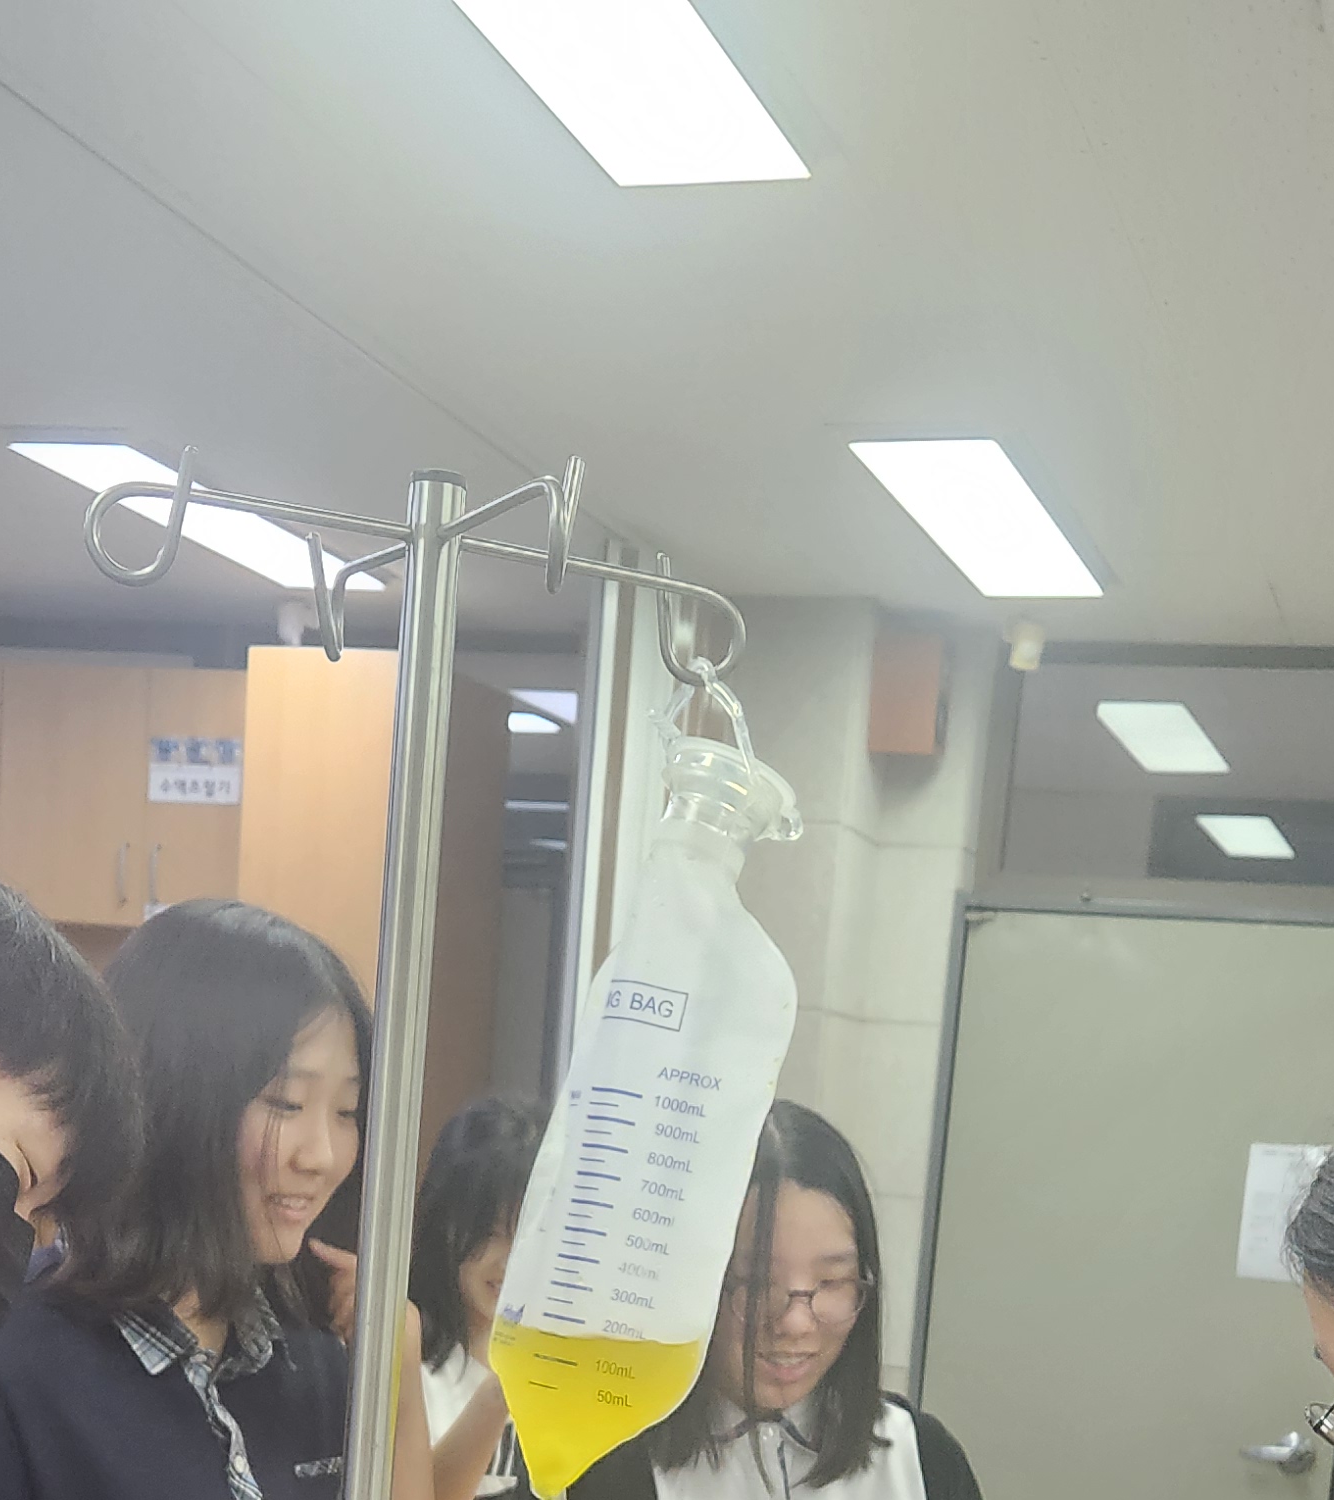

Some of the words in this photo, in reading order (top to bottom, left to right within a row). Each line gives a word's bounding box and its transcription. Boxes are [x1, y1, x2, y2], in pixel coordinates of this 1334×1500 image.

[629, 992, 674, 1018] BAG
[657, 1067, 722, 1091] APPROX
[654, 1095, 706, 1118] 1000mL
[654, 1123, 700, 1144] 900mL
[647, 1152, 693, 1173] 800mL
[641, 1179, 685, 1201] 700mL
[625, 1234, 670, 1256] 500mL
[610, 1288, 656, 1310] 300mL
[602, 1319, 646, 1340] 200mL
[595, 1360, 636, 1379] 100mL
[597, 1389, 633, 1408] 50mL
